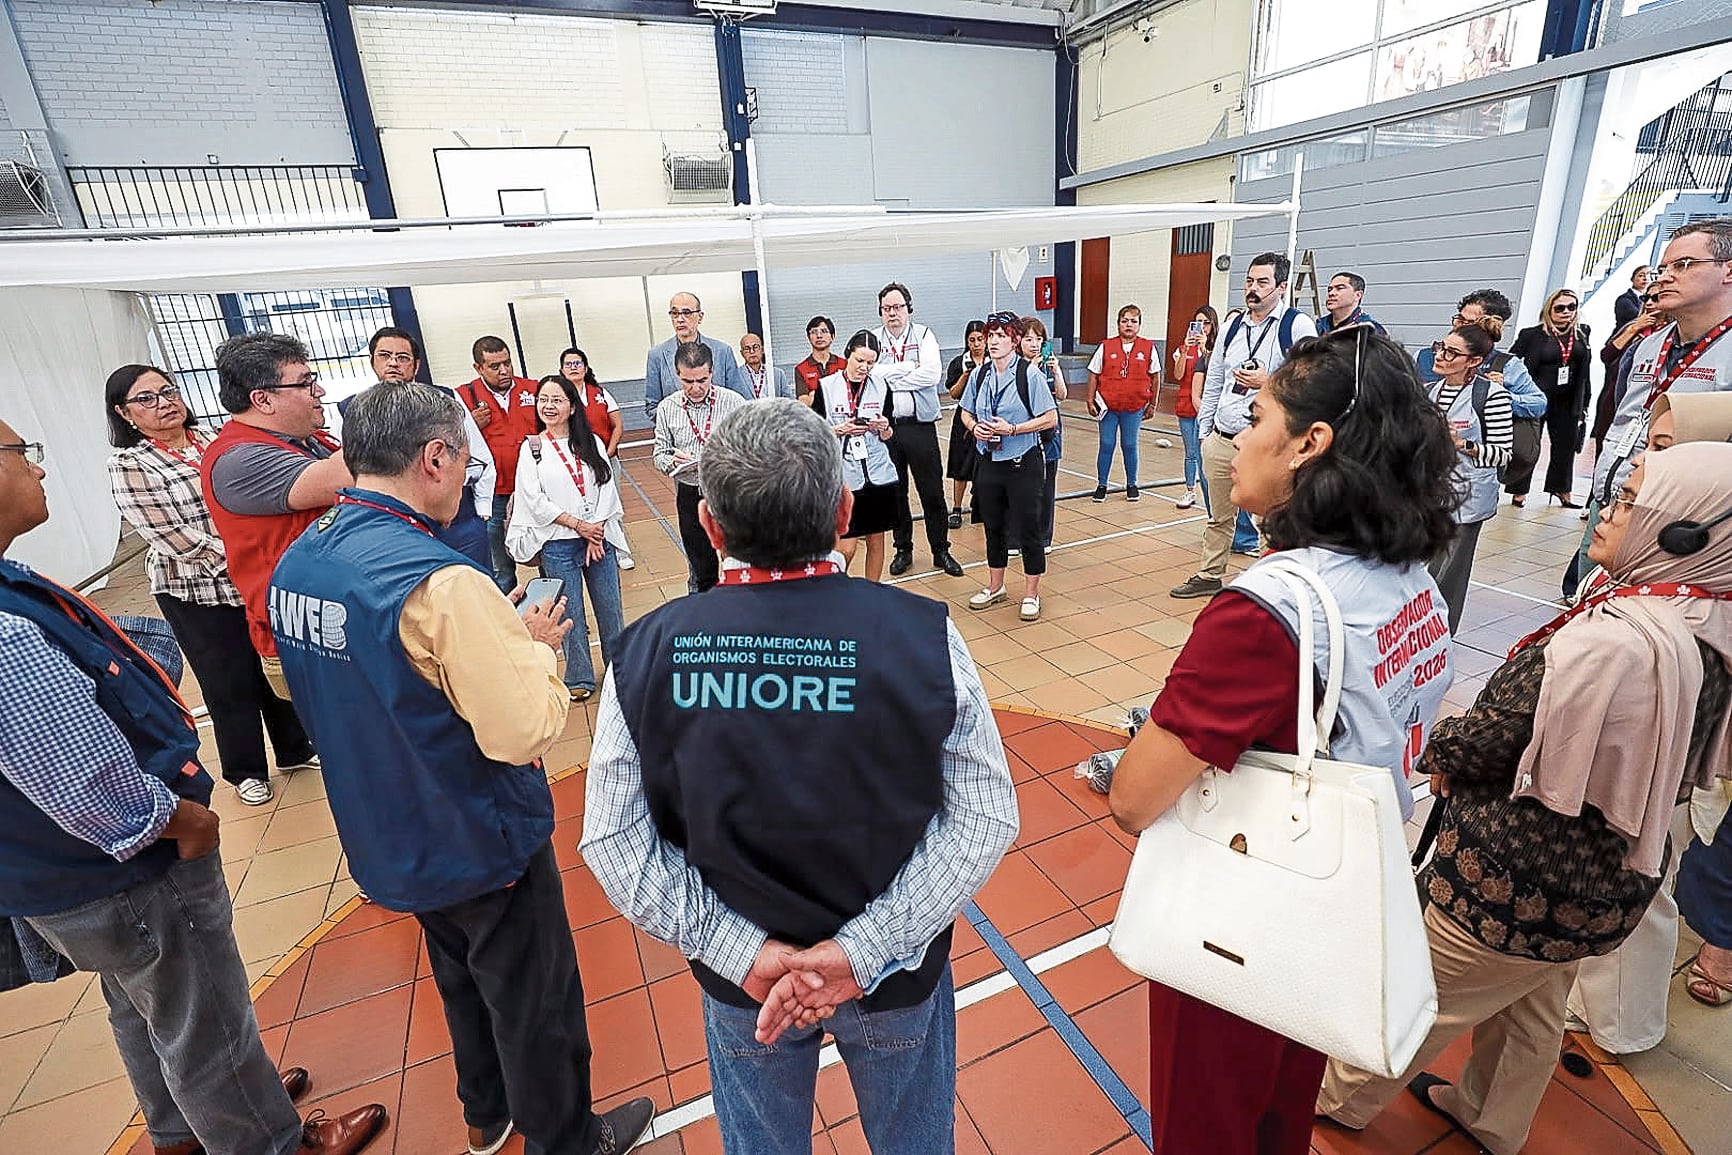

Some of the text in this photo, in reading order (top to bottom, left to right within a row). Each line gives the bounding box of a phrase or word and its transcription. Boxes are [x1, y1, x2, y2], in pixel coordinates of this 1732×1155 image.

[672, 651, 857, 668] ORGANISMOS ELECTORALES
[674, 632, 857, 652] UNIÓN INTERAMERICANA DE
[1373, 612, 1448, 689] INTERNCIONAL
[1413, 648, 1448, 688] 2026
[672, 671, 857, 712] UNIORE
